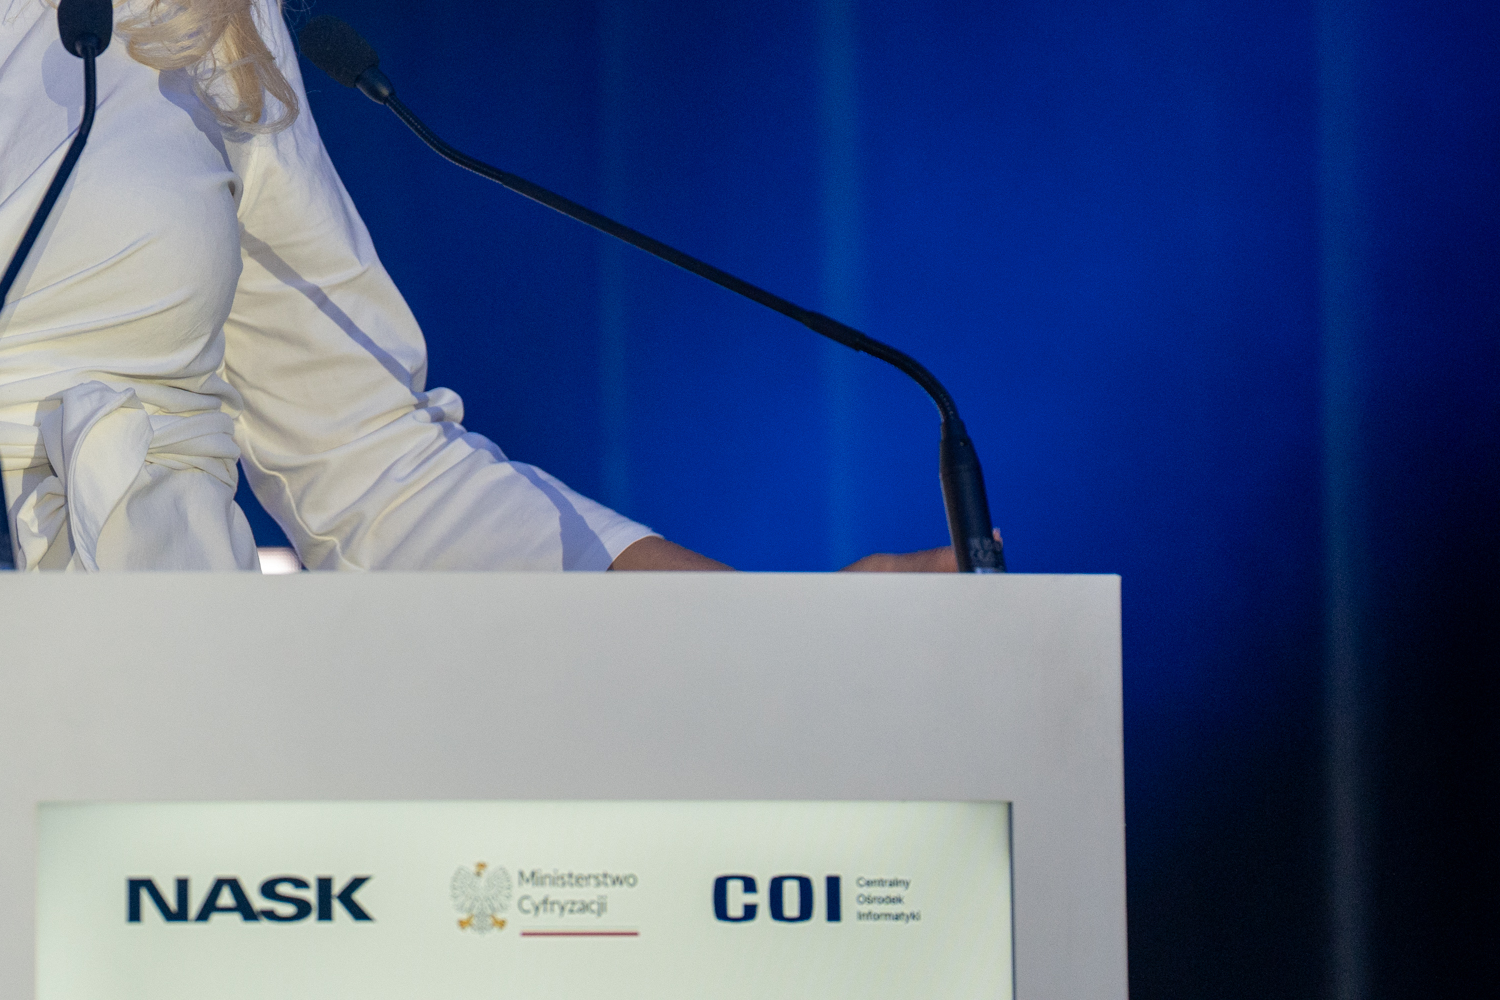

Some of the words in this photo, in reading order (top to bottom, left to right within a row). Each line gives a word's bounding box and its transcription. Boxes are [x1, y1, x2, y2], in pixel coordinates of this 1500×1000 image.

[517, 868, 639, 888] Ministerstwo
[856, 876, 911, 890] Centralny
[126, 876, 375, 923] NASK
[517, 895, 608, 918] Cyfryzacji
[713, 874, 842, 923] COI
[856, 893, 904, 906] Ośrodek
[856, 910, 921, 924] Informatyki
